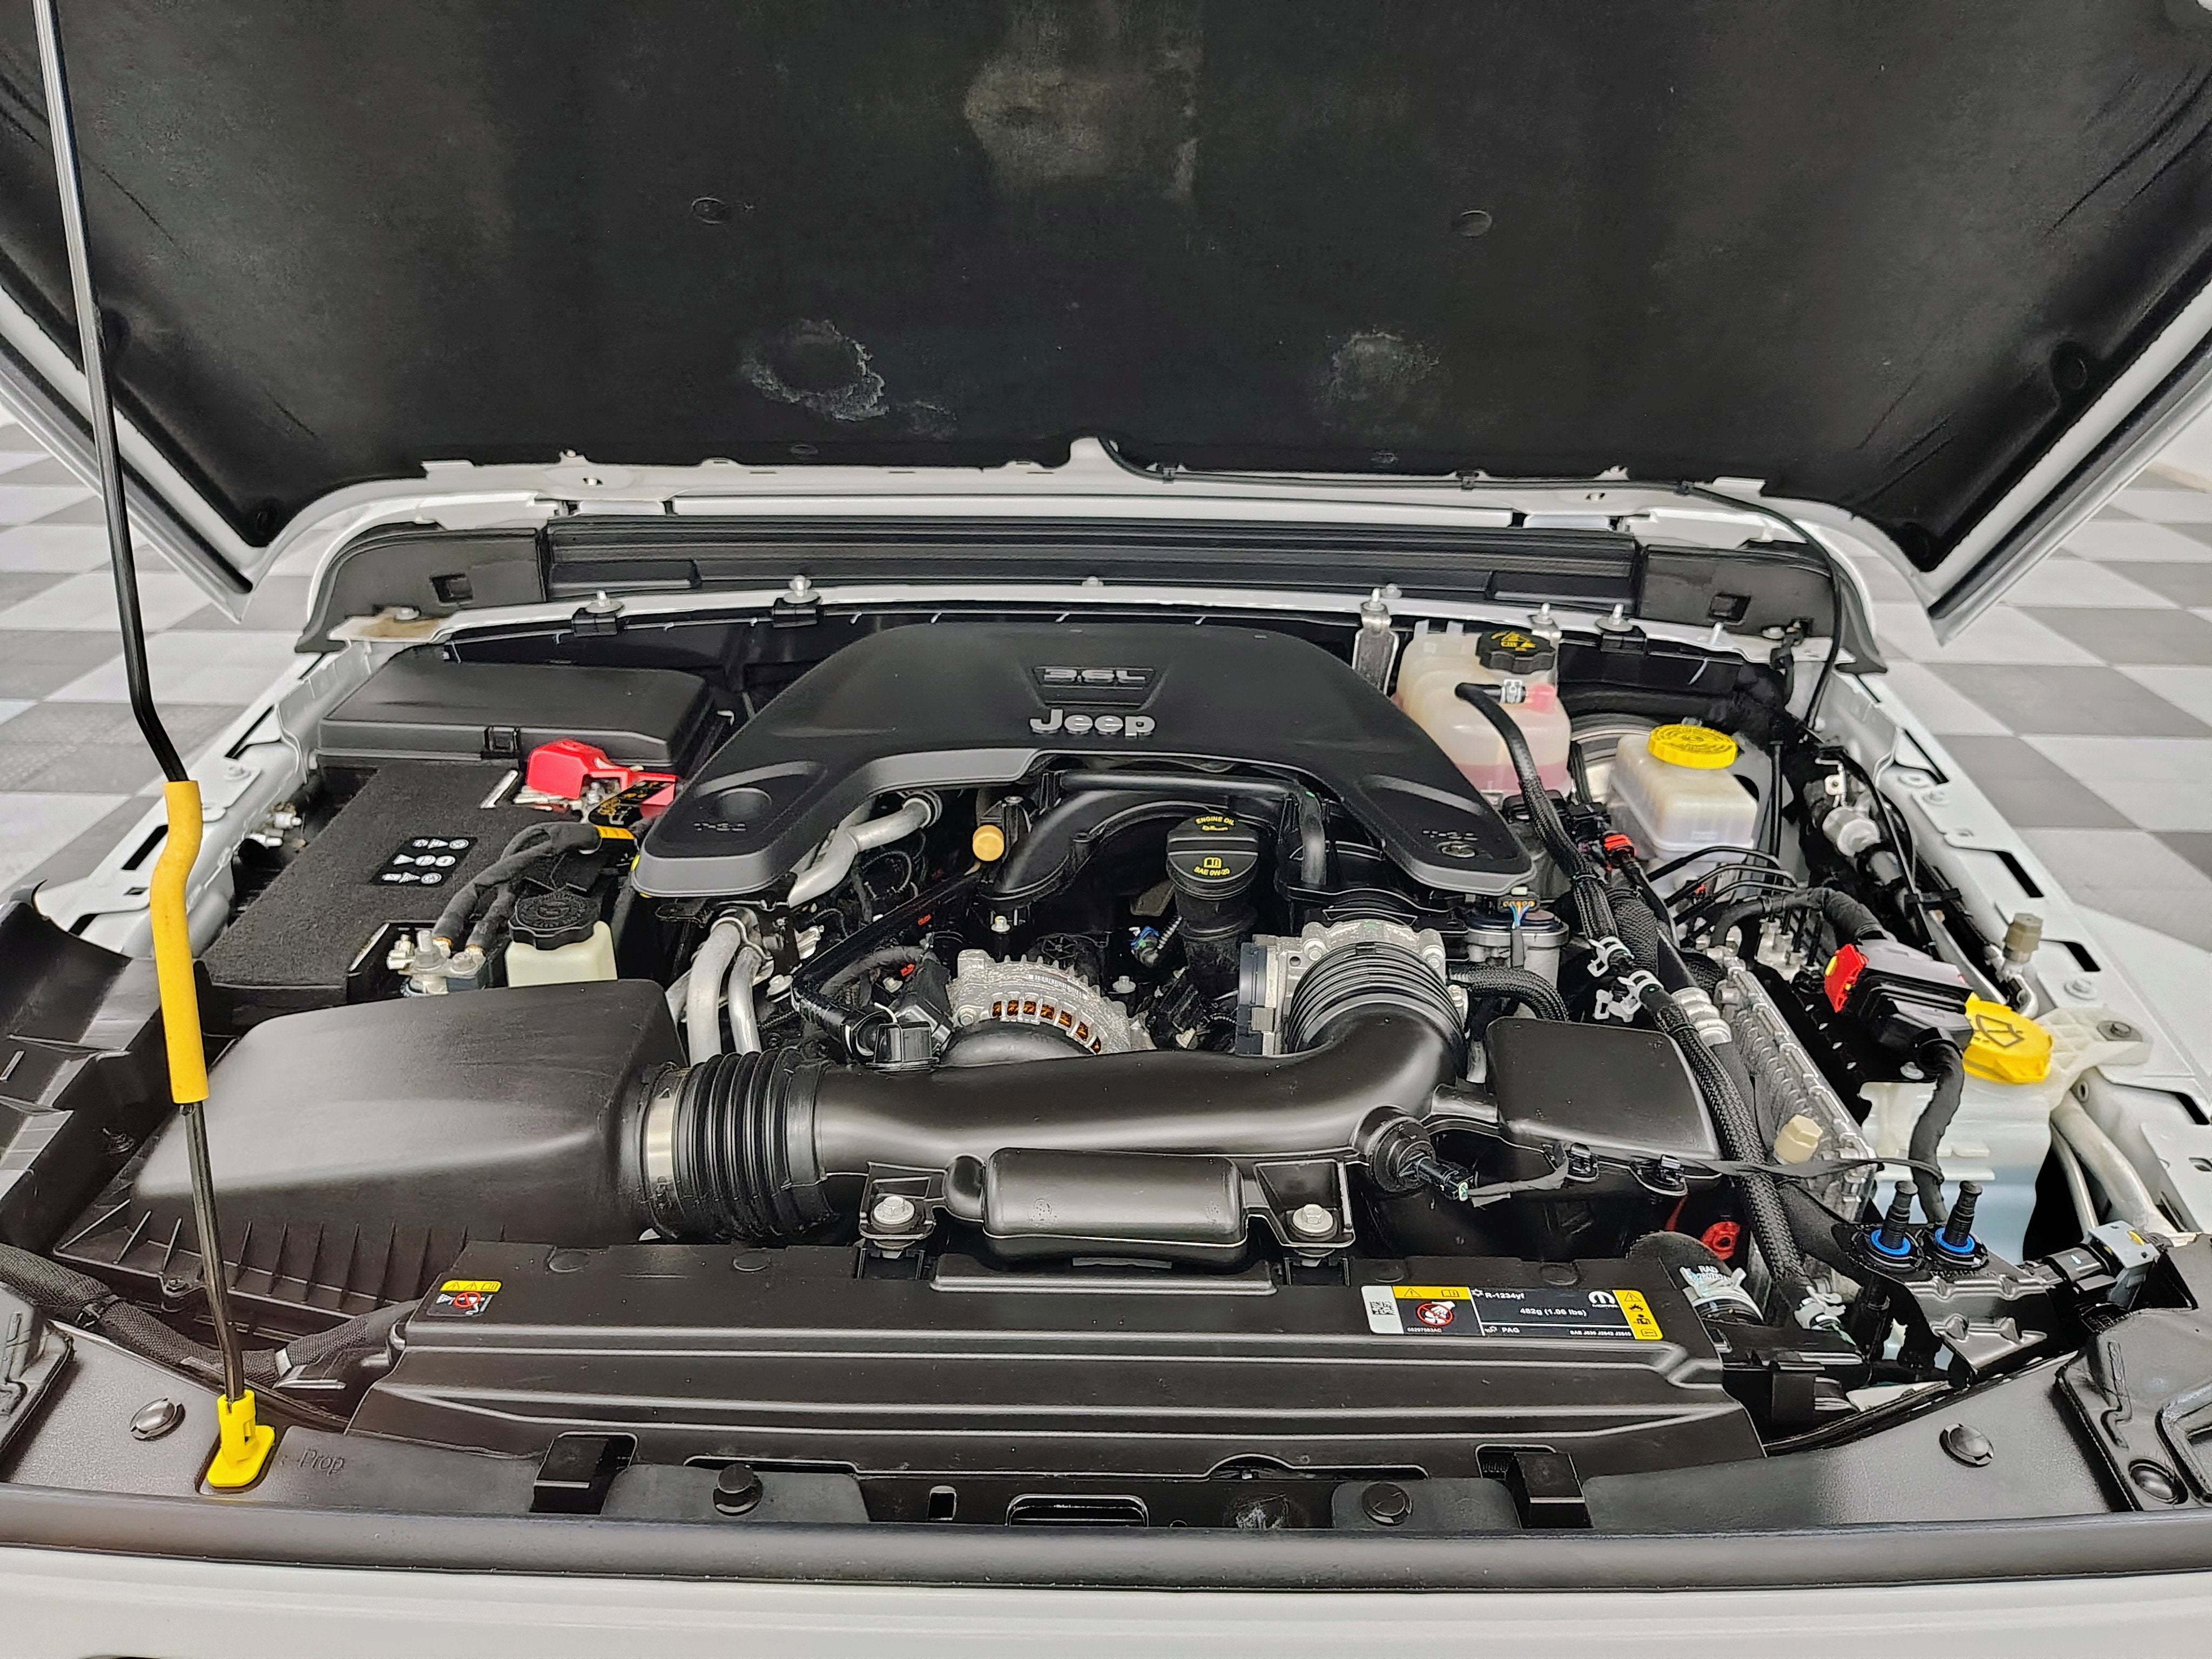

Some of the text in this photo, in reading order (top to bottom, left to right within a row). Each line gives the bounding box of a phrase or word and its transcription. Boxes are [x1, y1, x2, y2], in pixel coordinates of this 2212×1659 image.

[1029, 708, 1156, 737] Jeep
[1195, 815, 1235, 825] ENGINE OIL
[1697, 1265, 1719, 1273] RAD
